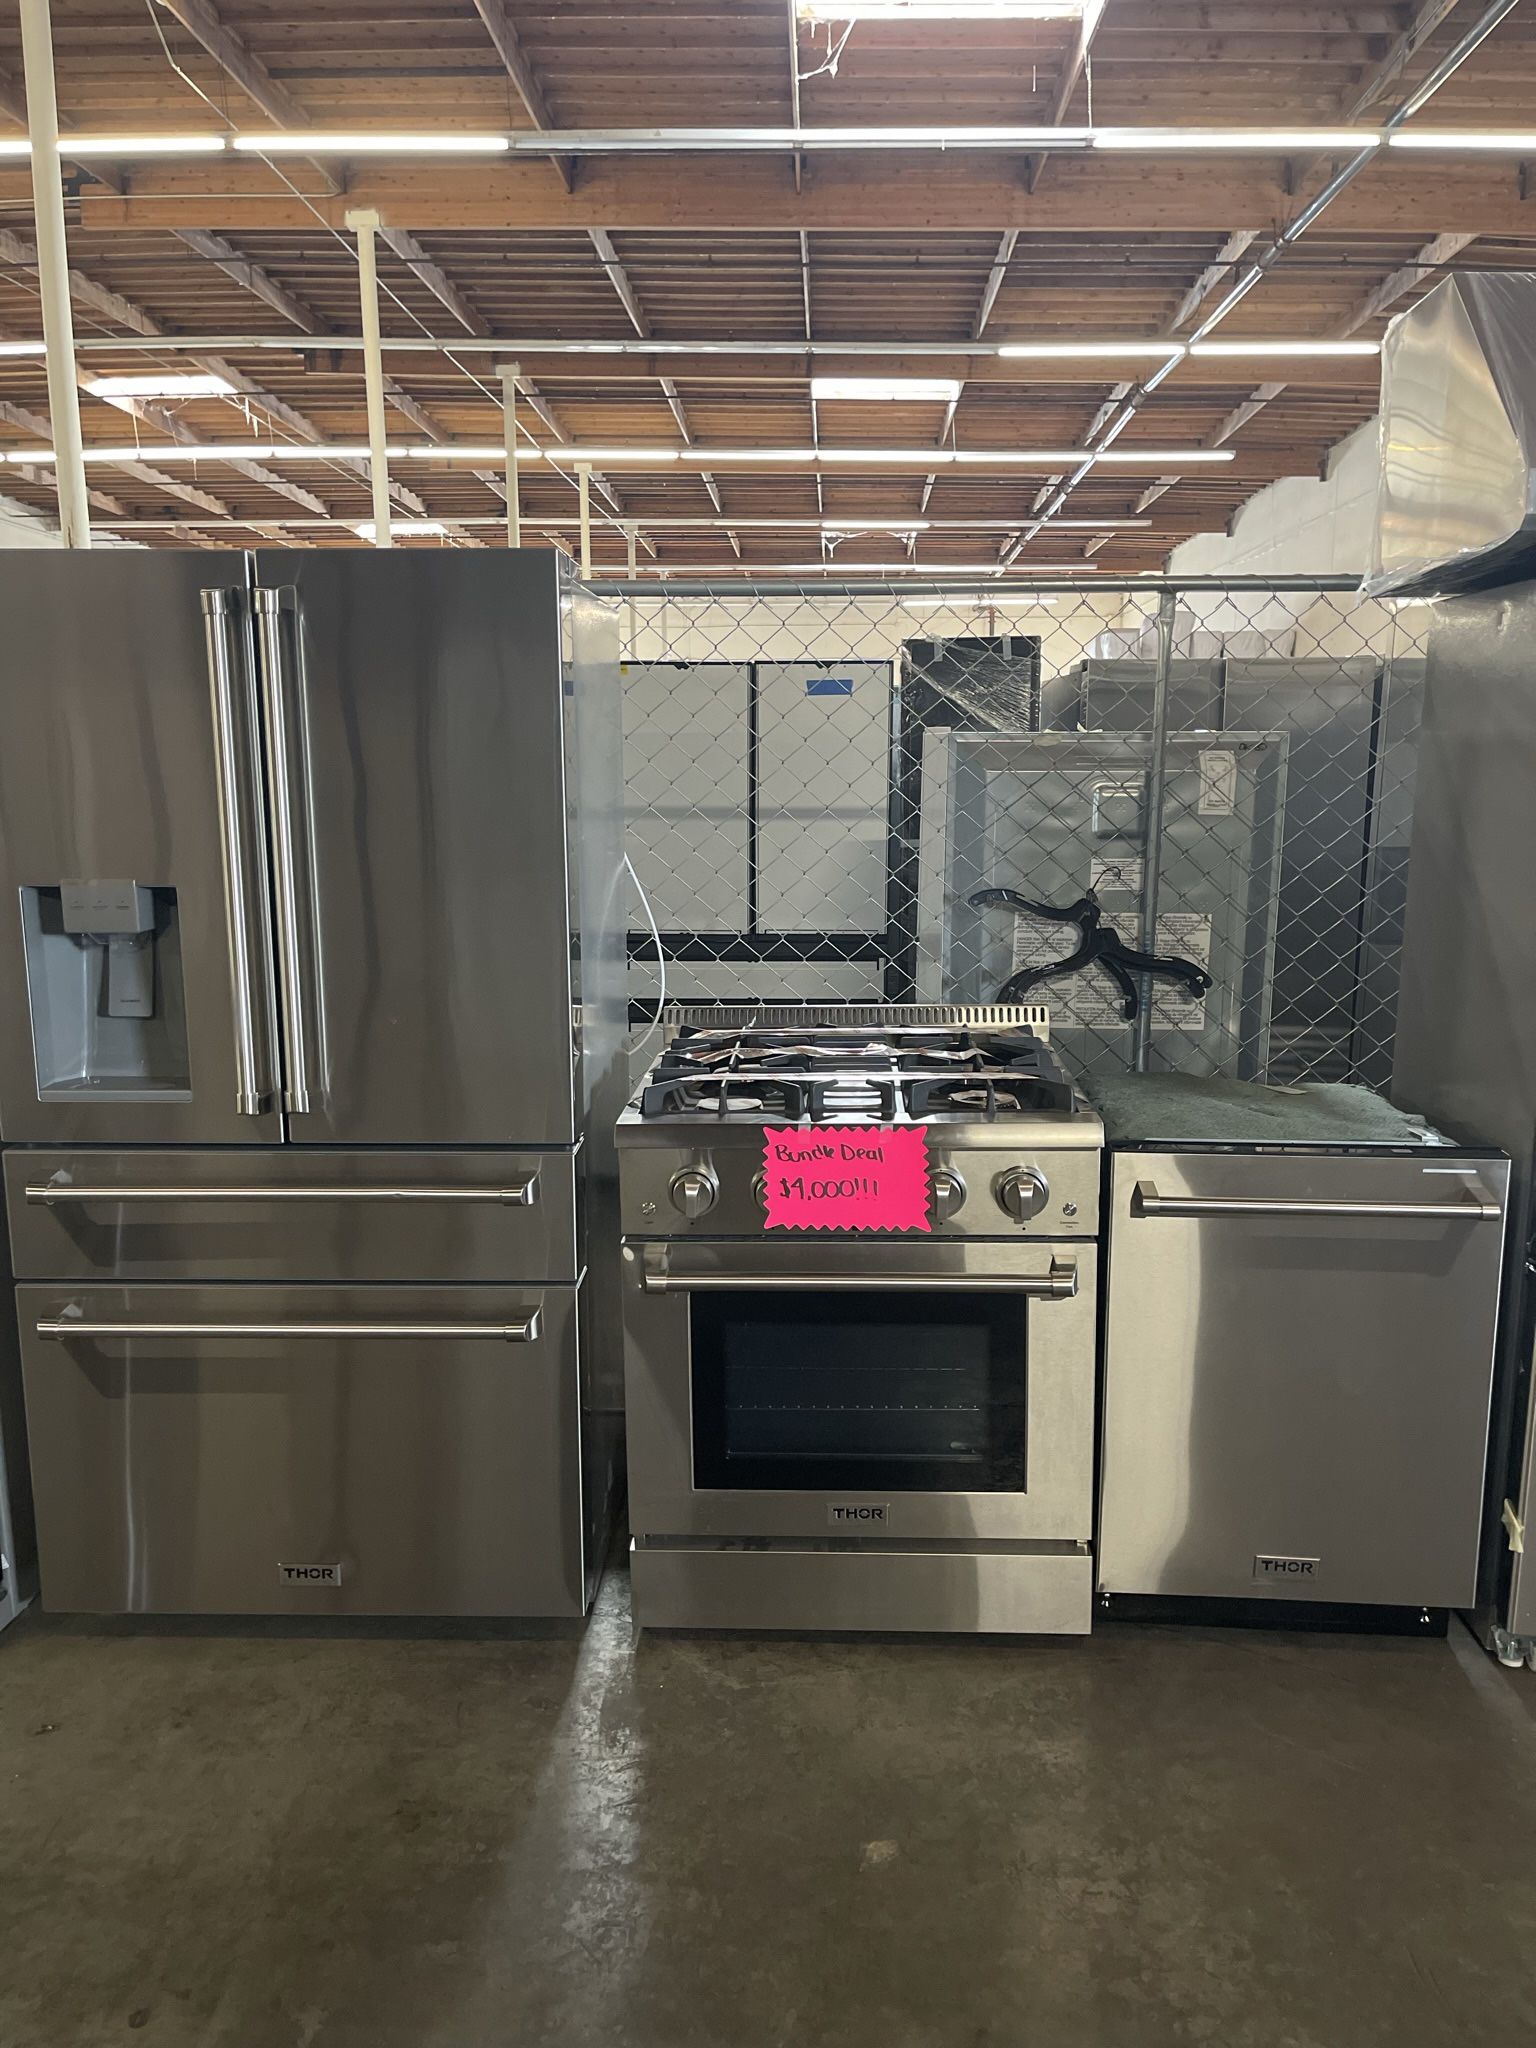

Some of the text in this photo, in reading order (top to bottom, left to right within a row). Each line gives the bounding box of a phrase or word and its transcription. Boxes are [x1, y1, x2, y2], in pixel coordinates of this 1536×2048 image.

[775, 1144, 883, 1163] Bundle Deal
[832, 1508, 883, 1520] THOR
[283, 1567, 334, 1579] THOR
[1261, 1560, 1313, 1574] THOR
